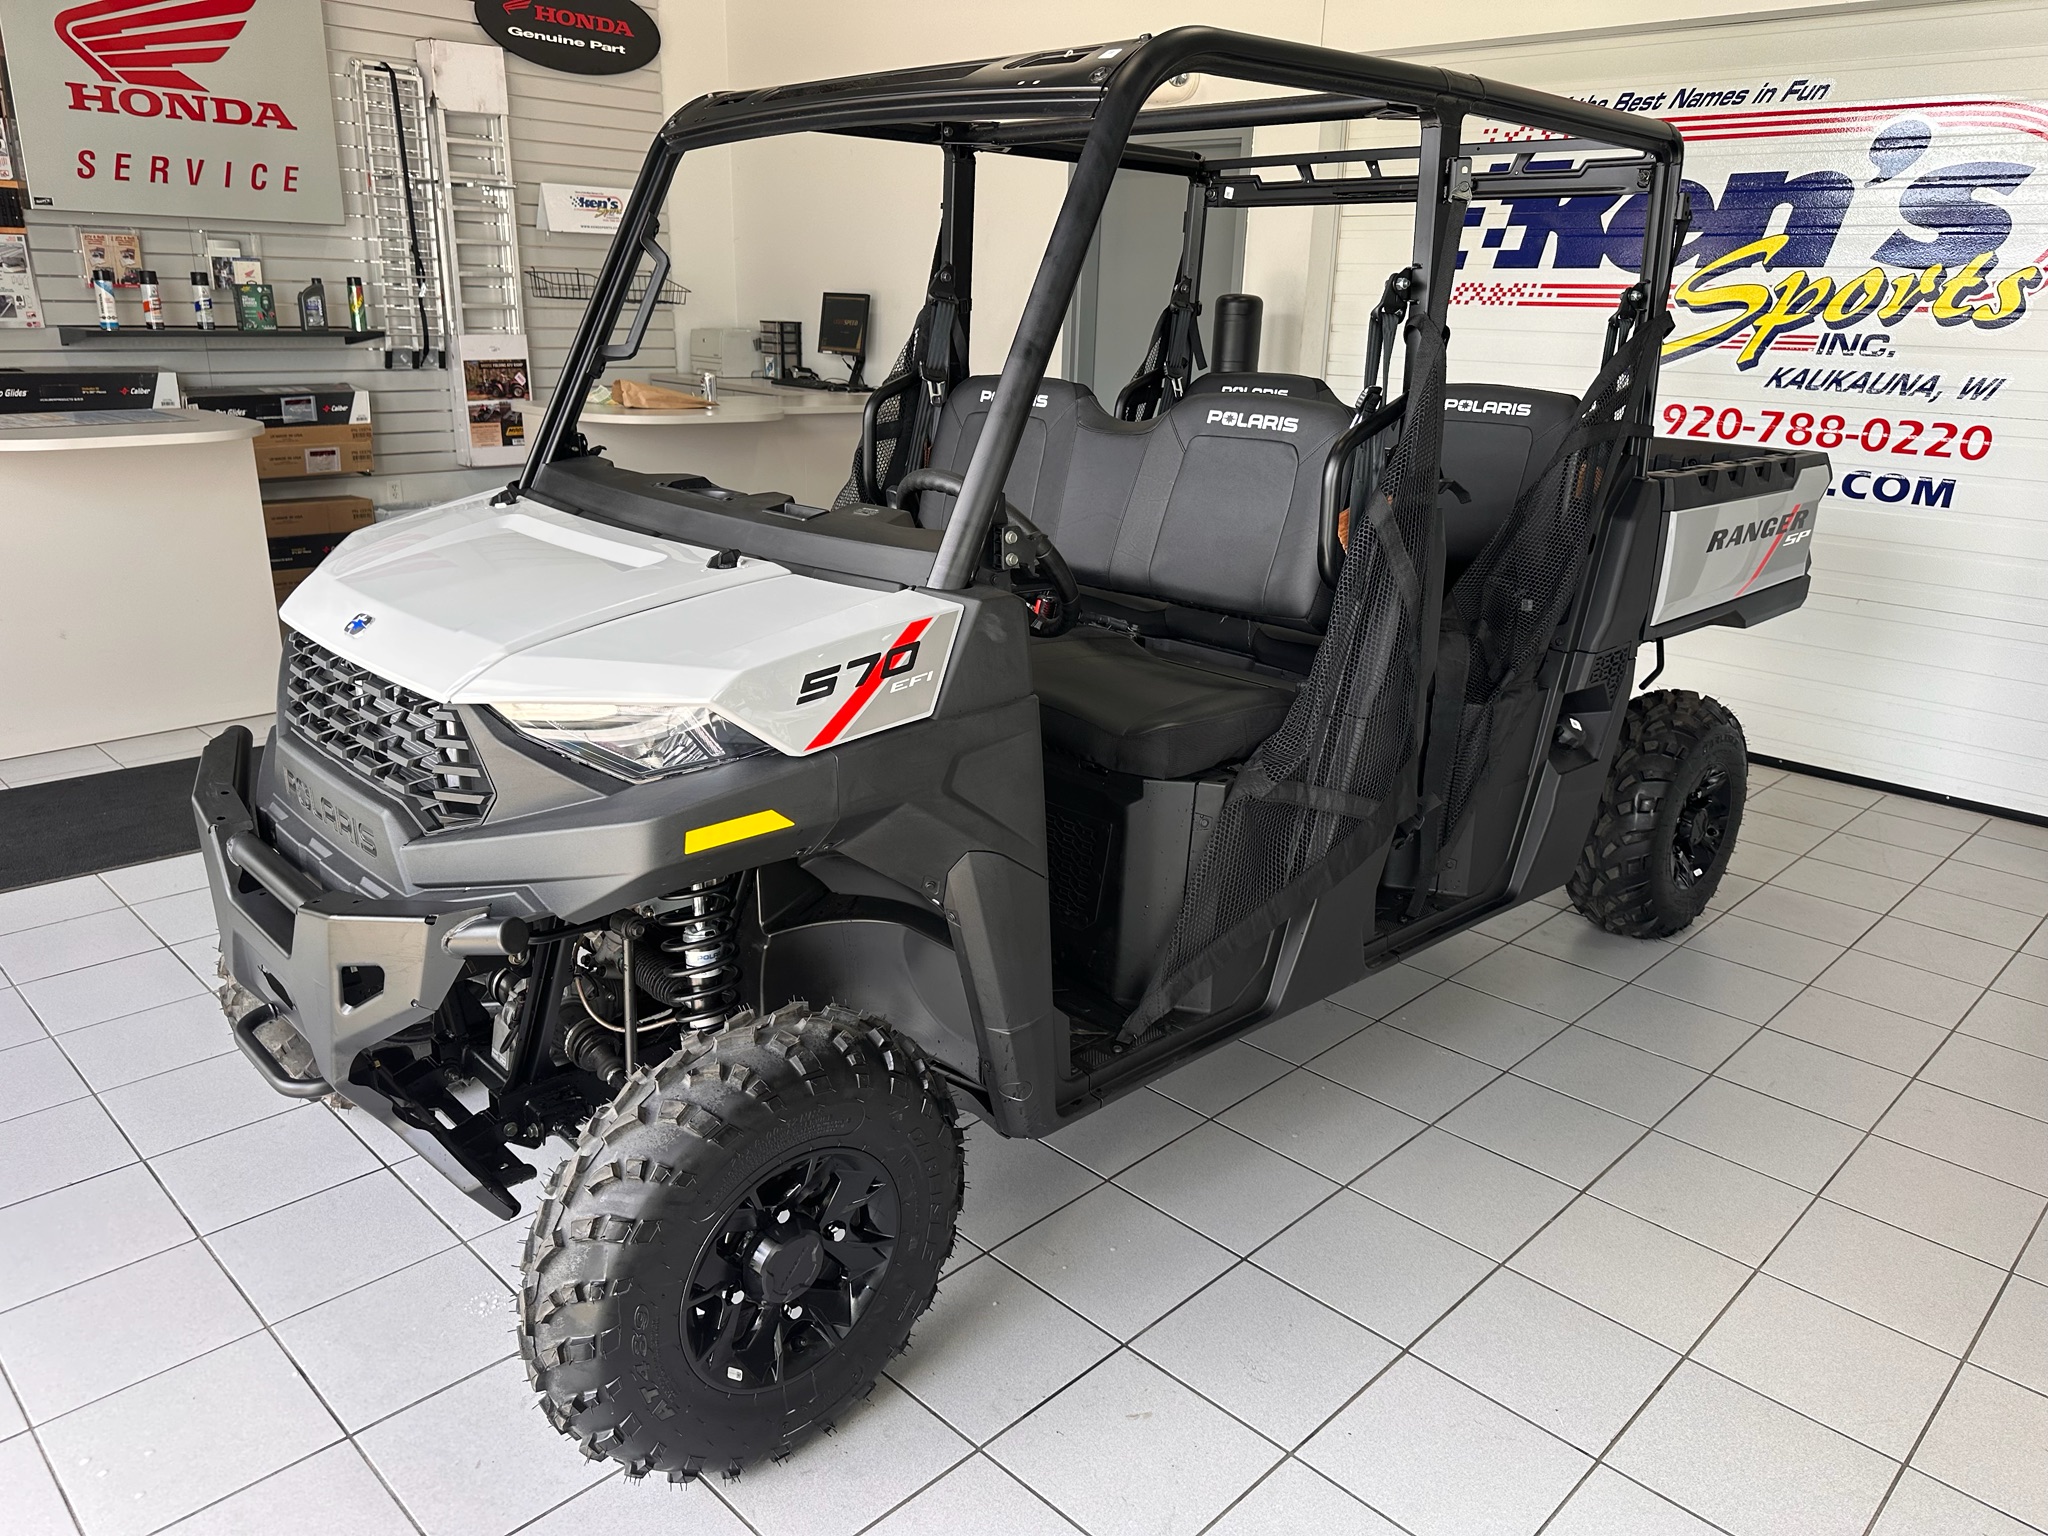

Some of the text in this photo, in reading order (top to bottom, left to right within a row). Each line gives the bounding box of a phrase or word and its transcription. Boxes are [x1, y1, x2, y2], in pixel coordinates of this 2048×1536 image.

[534, 4, 635, 38] HONDA
[507, 26, 626, 55] Genuine Part
[64, 81, 298, 131] HONDA
[1613, 91, 1667, 112] Best
[1668, 84, 1748, 110] Names
[1752, 82, 1778, 104] in
[1786, 79, 1831, 102] Fun
[76, 149, 299, 193] SERVICE
[1660, 234, 2043, 372] Sports
[1816, 332, 1896, 359] INC.
[5, 388, 27, 398] Glides
[130, 387, 151, 395] Caliber
[1763, 367, 2008, 404] KAUKAUNA, WI
[331, 404, 349, 412] Caliber
[1206, 409, 1299, 433] POLARIS
[1444, 398, 1532, 417] POLARIS
[1663, 403, 1994, 462] 920-788-0220
[1826, 470, 1957, 509] .COM
[1706, 508, 1809, 554] RANGER
[1782, 529, 1812, 548] SP
[796, 640, 921, 706] 570
[890, 670, 934, 704] EFI
[283, 766, 378, 858] POLARIS
